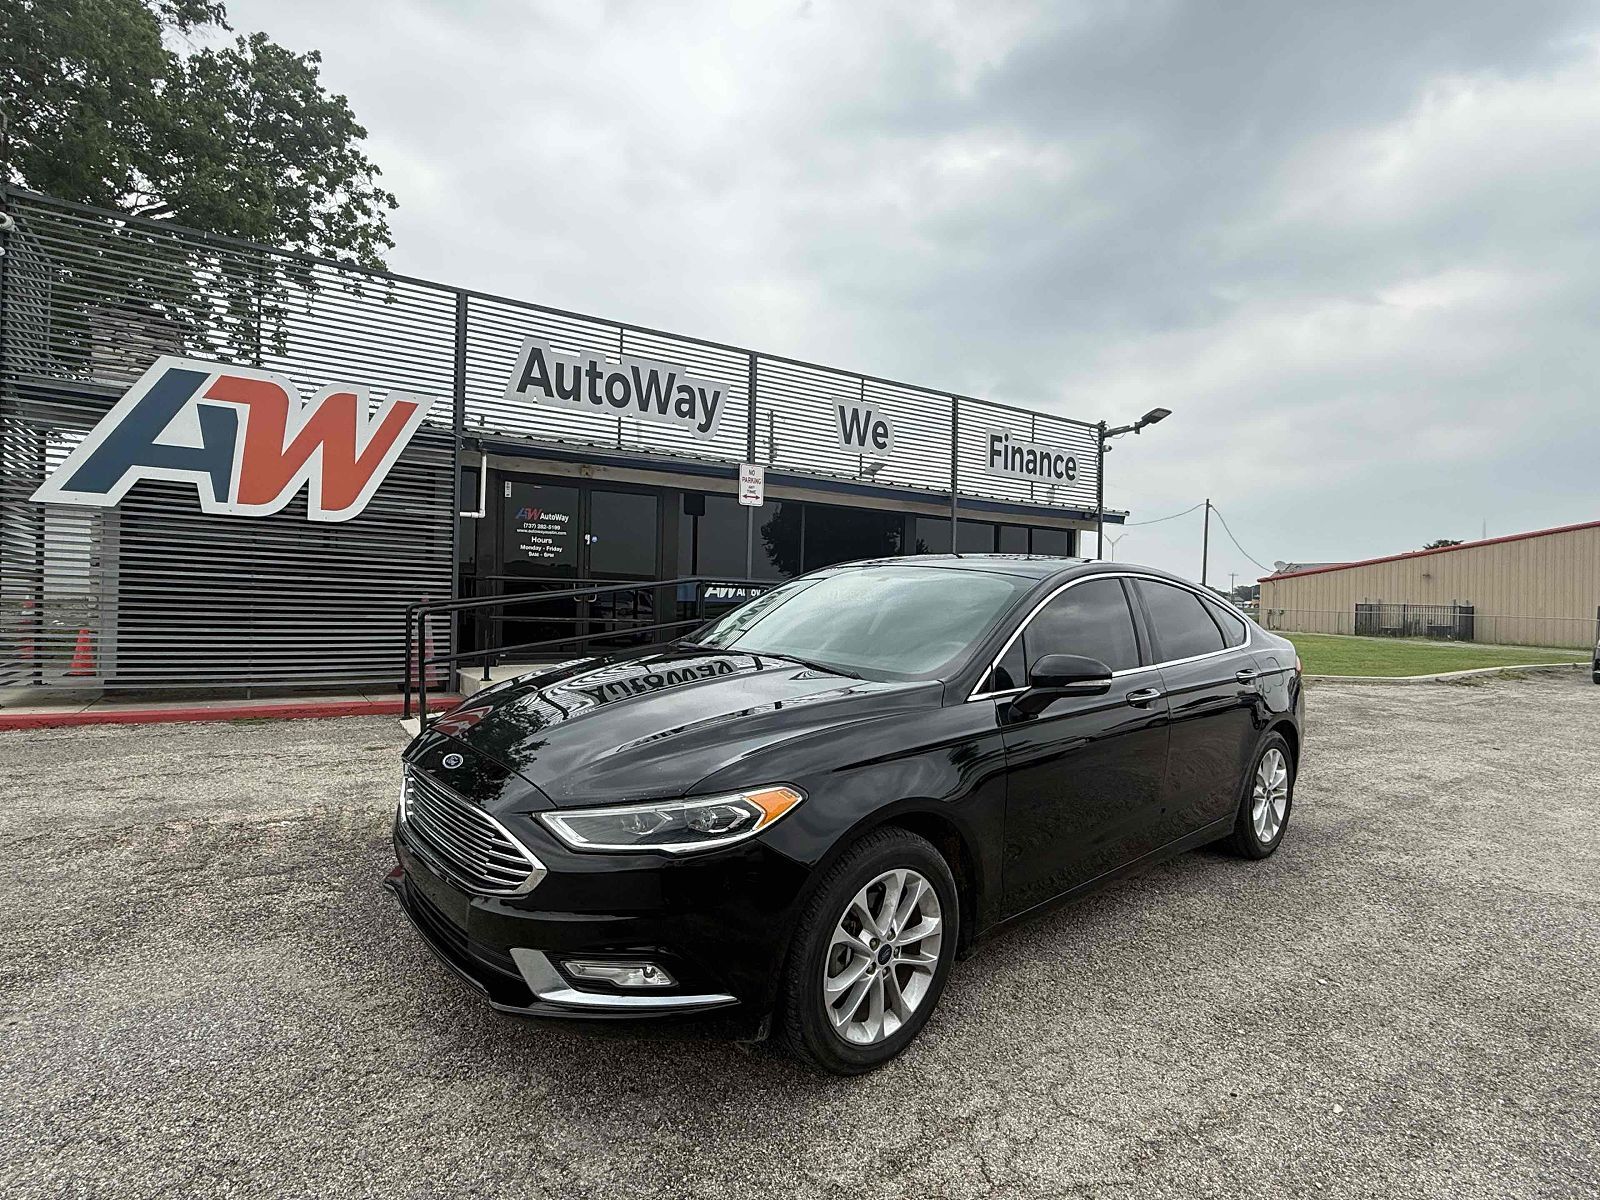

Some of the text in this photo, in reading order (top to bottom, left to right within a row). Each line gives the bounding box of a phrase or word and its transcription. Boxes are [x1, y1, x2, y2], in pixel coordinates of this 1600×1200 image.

[516, 346, 721, 434] AutoWay
[58, 367, 421, 511] AW
[838, 404, 1077, 481] We Finance
[742, 476, 762, 485] PARKING
[515, 507, 569, 523] AW AutoWay
[531, 536, 552, 544] Hours
[520, 544, 542, 552] Monday
[546, 545, 563, 553] Friday
